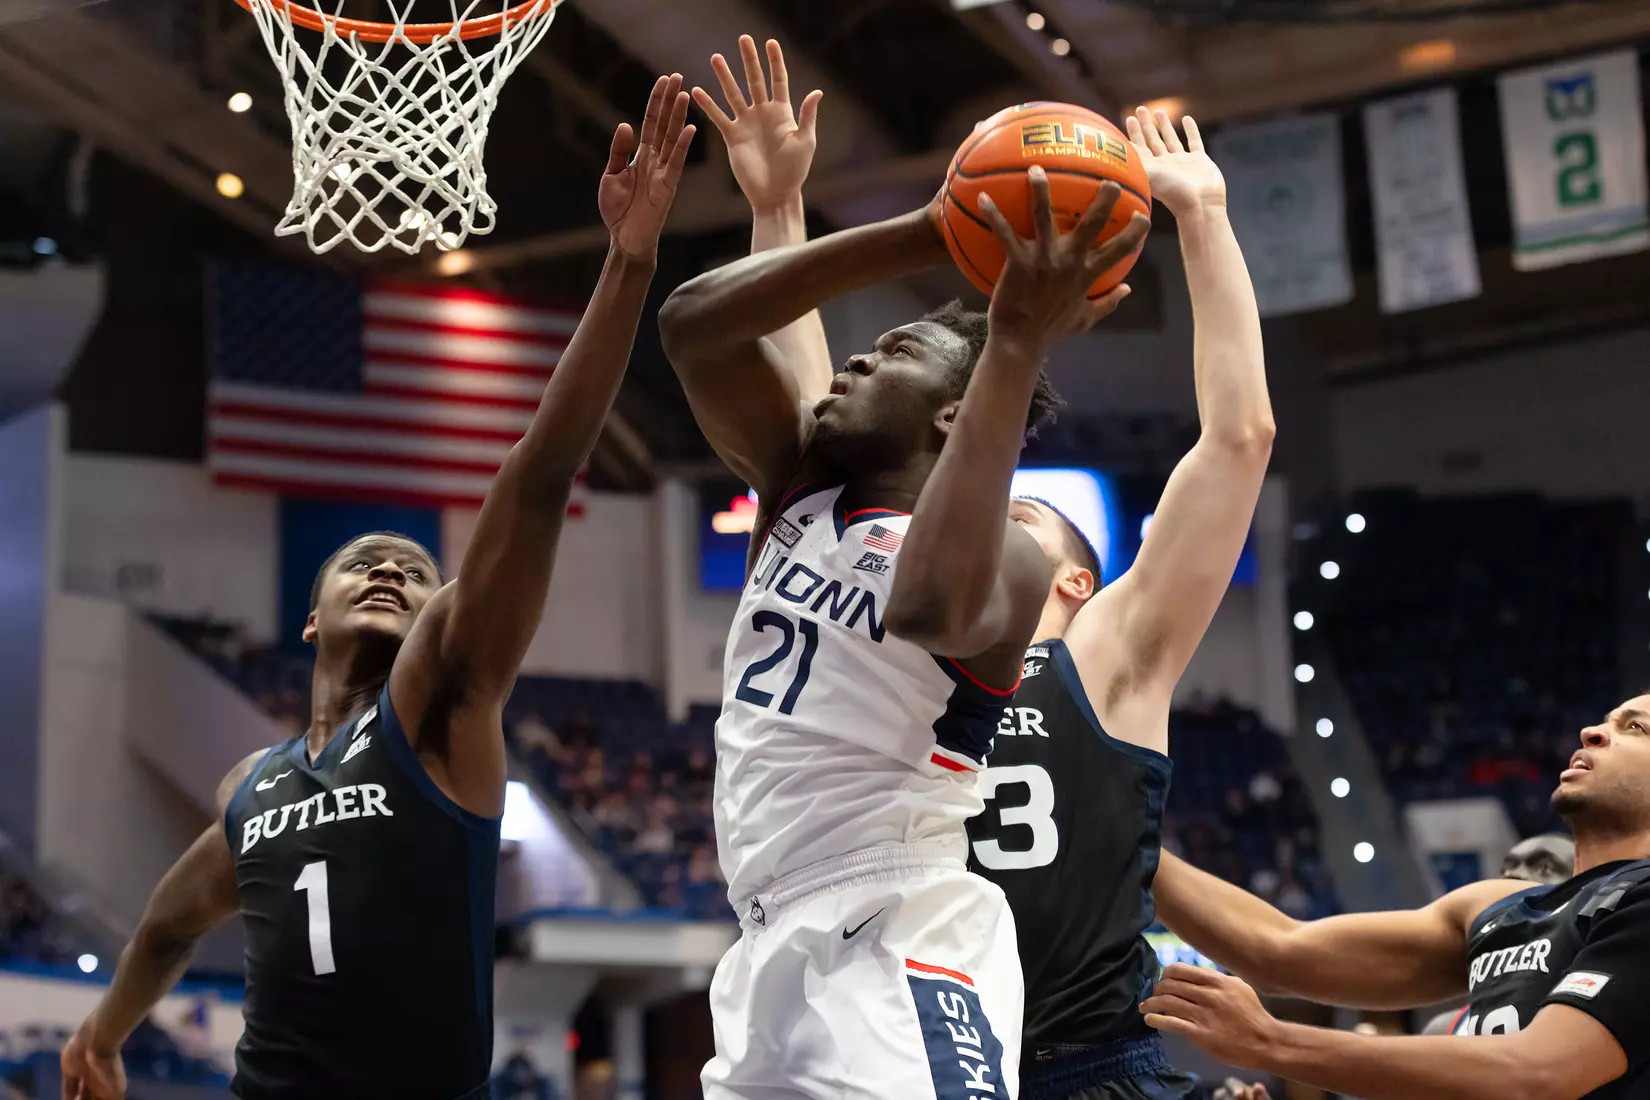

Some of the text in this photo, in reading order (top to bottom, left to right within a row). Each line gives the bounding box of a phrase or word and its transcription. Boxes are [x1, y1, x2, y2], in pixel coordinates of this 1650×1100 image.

[1022, 121, 1127, 163] ELITE
[1555, 132, 1602, 205] 2
[856, 559, 890, 572] EAST
[862, 551, 888, 564] BIG
[735, 610, 819, 716] 21
[240, 783, 394, 855] BUTLER
[971, 764, 1059, 870] 3
[293, 860, 337, 976] 1
[1468, 938, 1552, 994] BUTLER
[936, 990, 996, 1100] KIES
